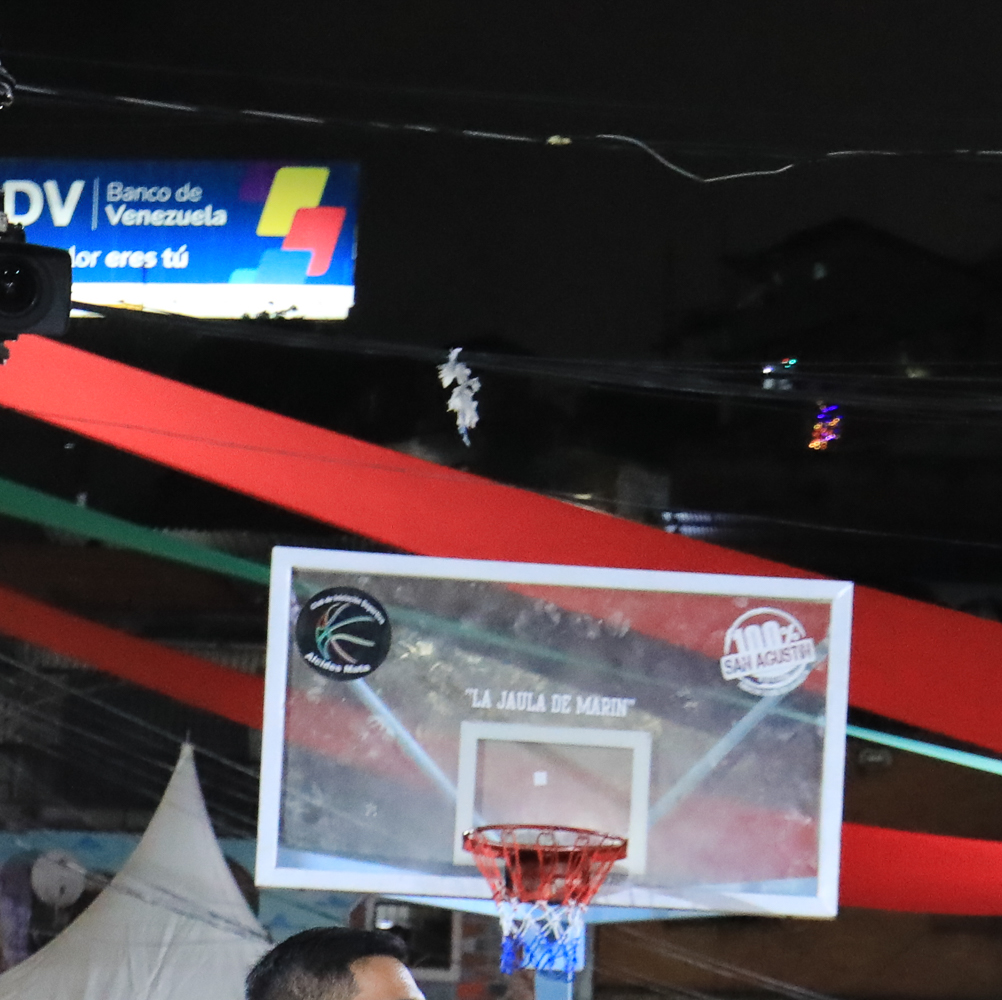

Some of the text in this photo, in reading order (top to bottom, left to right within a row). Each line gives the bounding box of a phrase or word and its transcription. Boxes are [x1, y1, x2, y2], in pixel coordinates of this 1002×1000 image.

[106, 181, 203, 202] Banco de
[104, 203, 228, 226] Venezuela
[68, 244, 190, 268] lor eres tú
[733, 620, 801, 652] 100%
[724, 657, 752, 675] SAN
[465, 687, 492, 708] "LA
[497, 690, 547, 713] JAULA
[551, 694, 572, 714] DE
